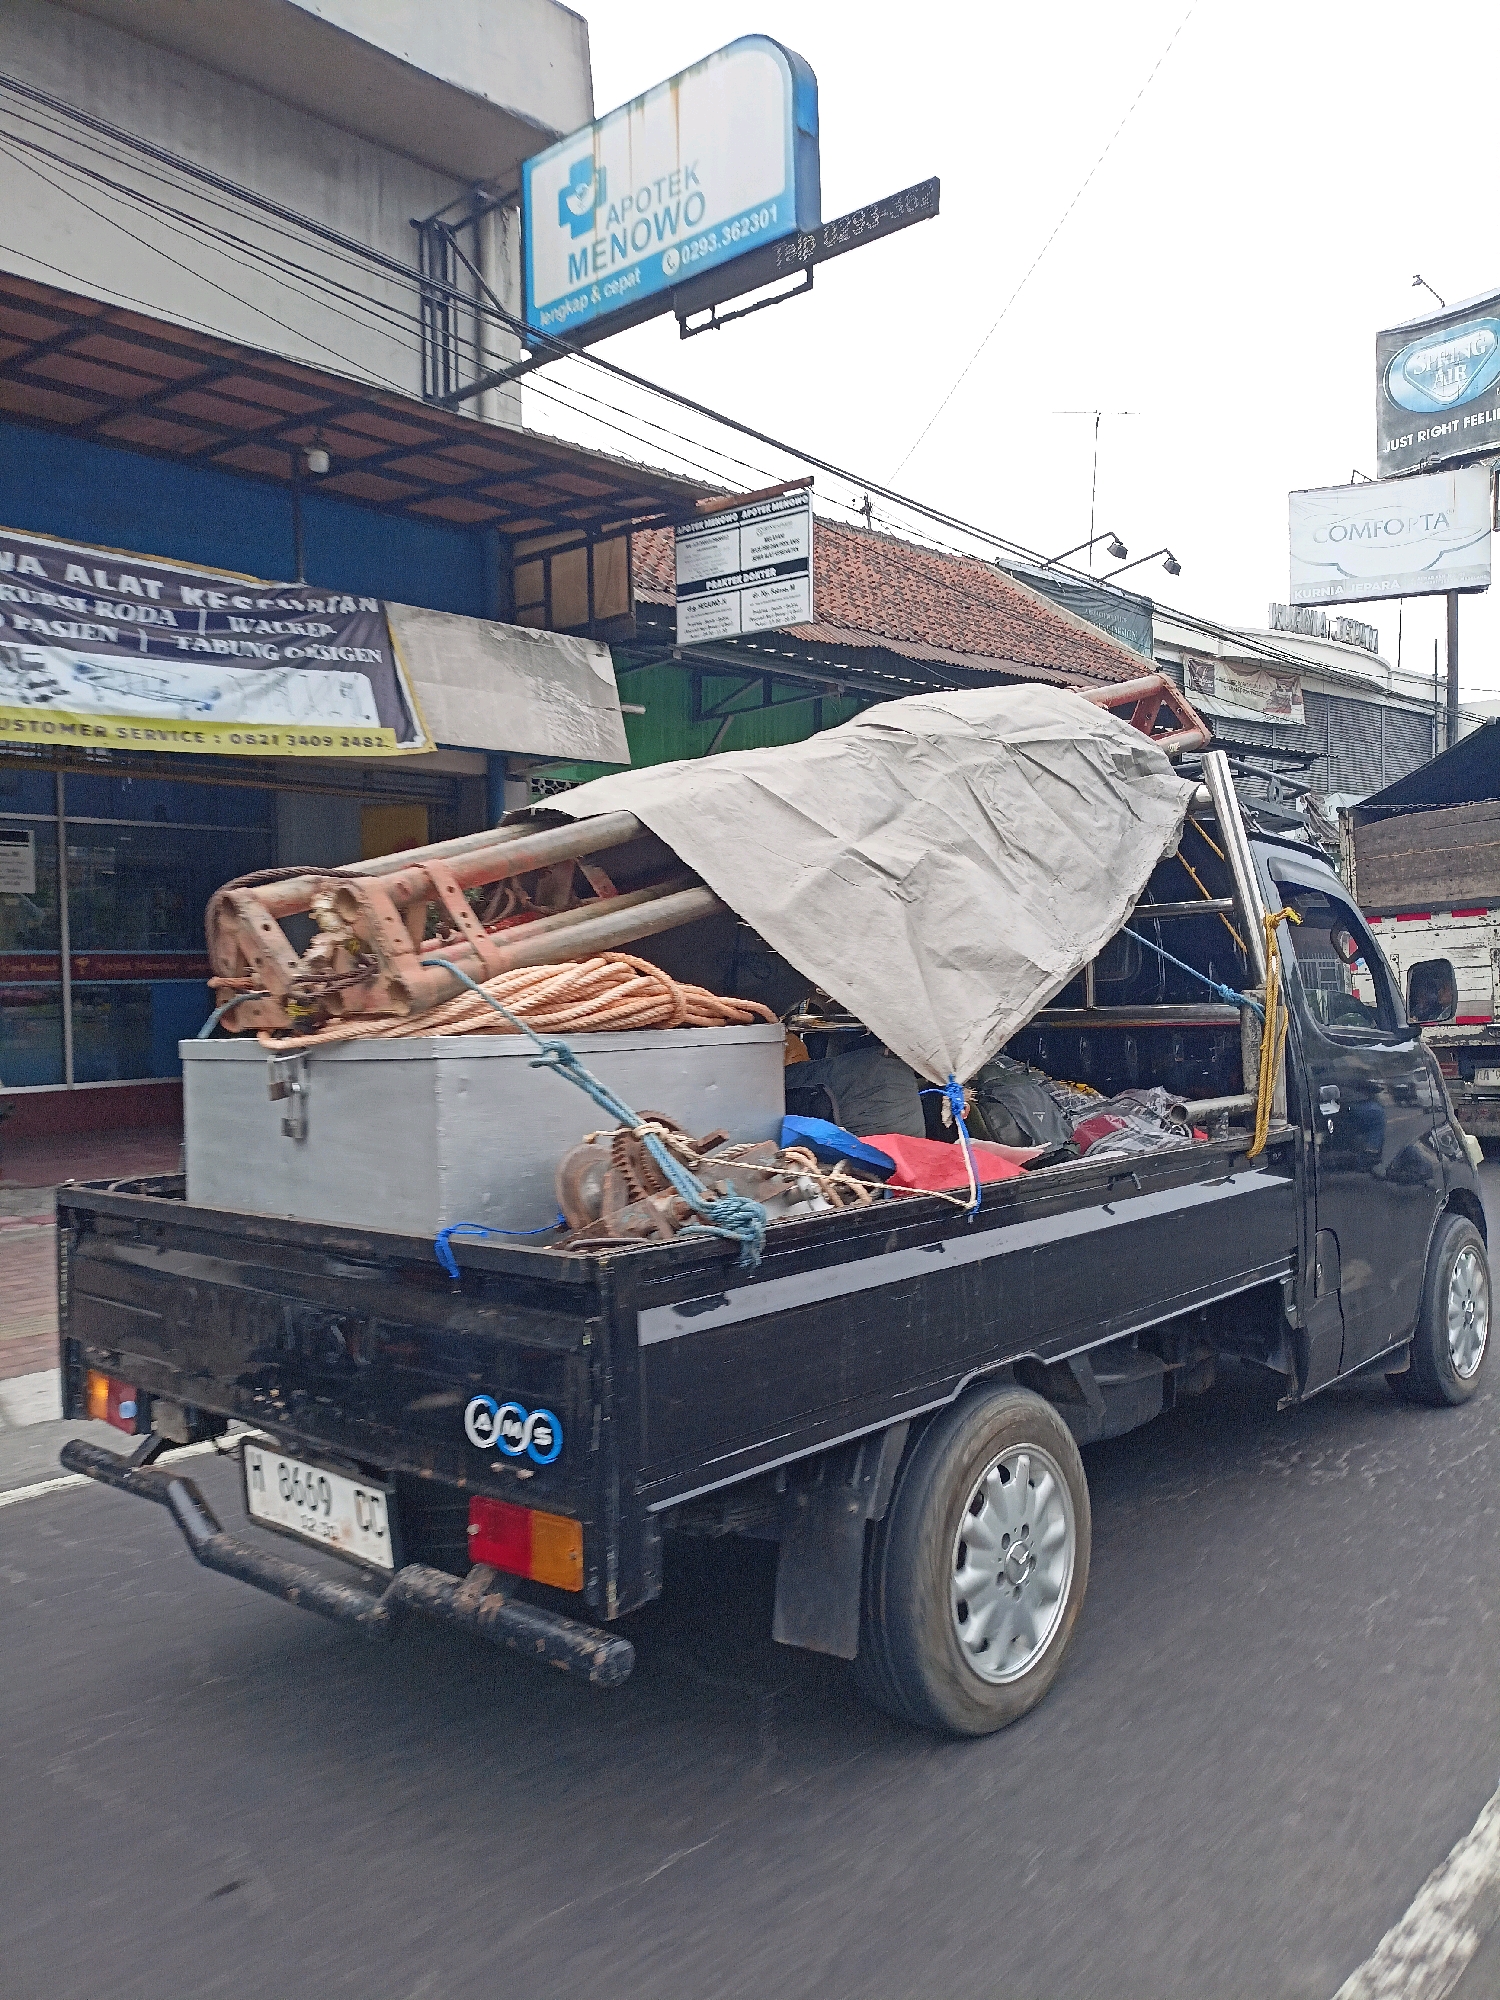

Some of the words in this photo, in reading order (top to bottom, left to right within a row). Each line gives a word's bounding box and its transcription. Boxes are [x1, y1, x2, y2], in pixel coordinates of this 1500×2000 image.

[605, 159, 701, 231] APOTEK
[568, 191, 706, 285] MENOWO
[681, 203, 778, 266] 0293.362301
[540, 294, 589, 327] lengkap
[591, 285, 602, 305] &
[603, 267, 642, 299] cepat
[1413, 337, 1487, 376] SPRING
[1433, 366, 1468, 390] AIR
[1383, 434, 1414, 453] JUST
[1417, 419, 1460, 443] RIGHT
[1313, 511, 1450, 544] COMFORTA
[64, 563, 165, 600] ALAT
[1294, 585, 1344, 600] KURNIA
[1349, 579, 1400, 593] JEPARA
[94, 600, 178, 627] RODA
[11, 613, 119, 643] PASIEN
[170, 635, 280, 661] TABUNG
[116, 727, 205, 744] SERVICE
[229, 733, 280, 746] 0821
[285, 734, 333, 747] 3409
[340, 736, 384, 748] 2482
[249, 1452, 266, 1492] H
[277, 1461, 333, 1517] 8669
